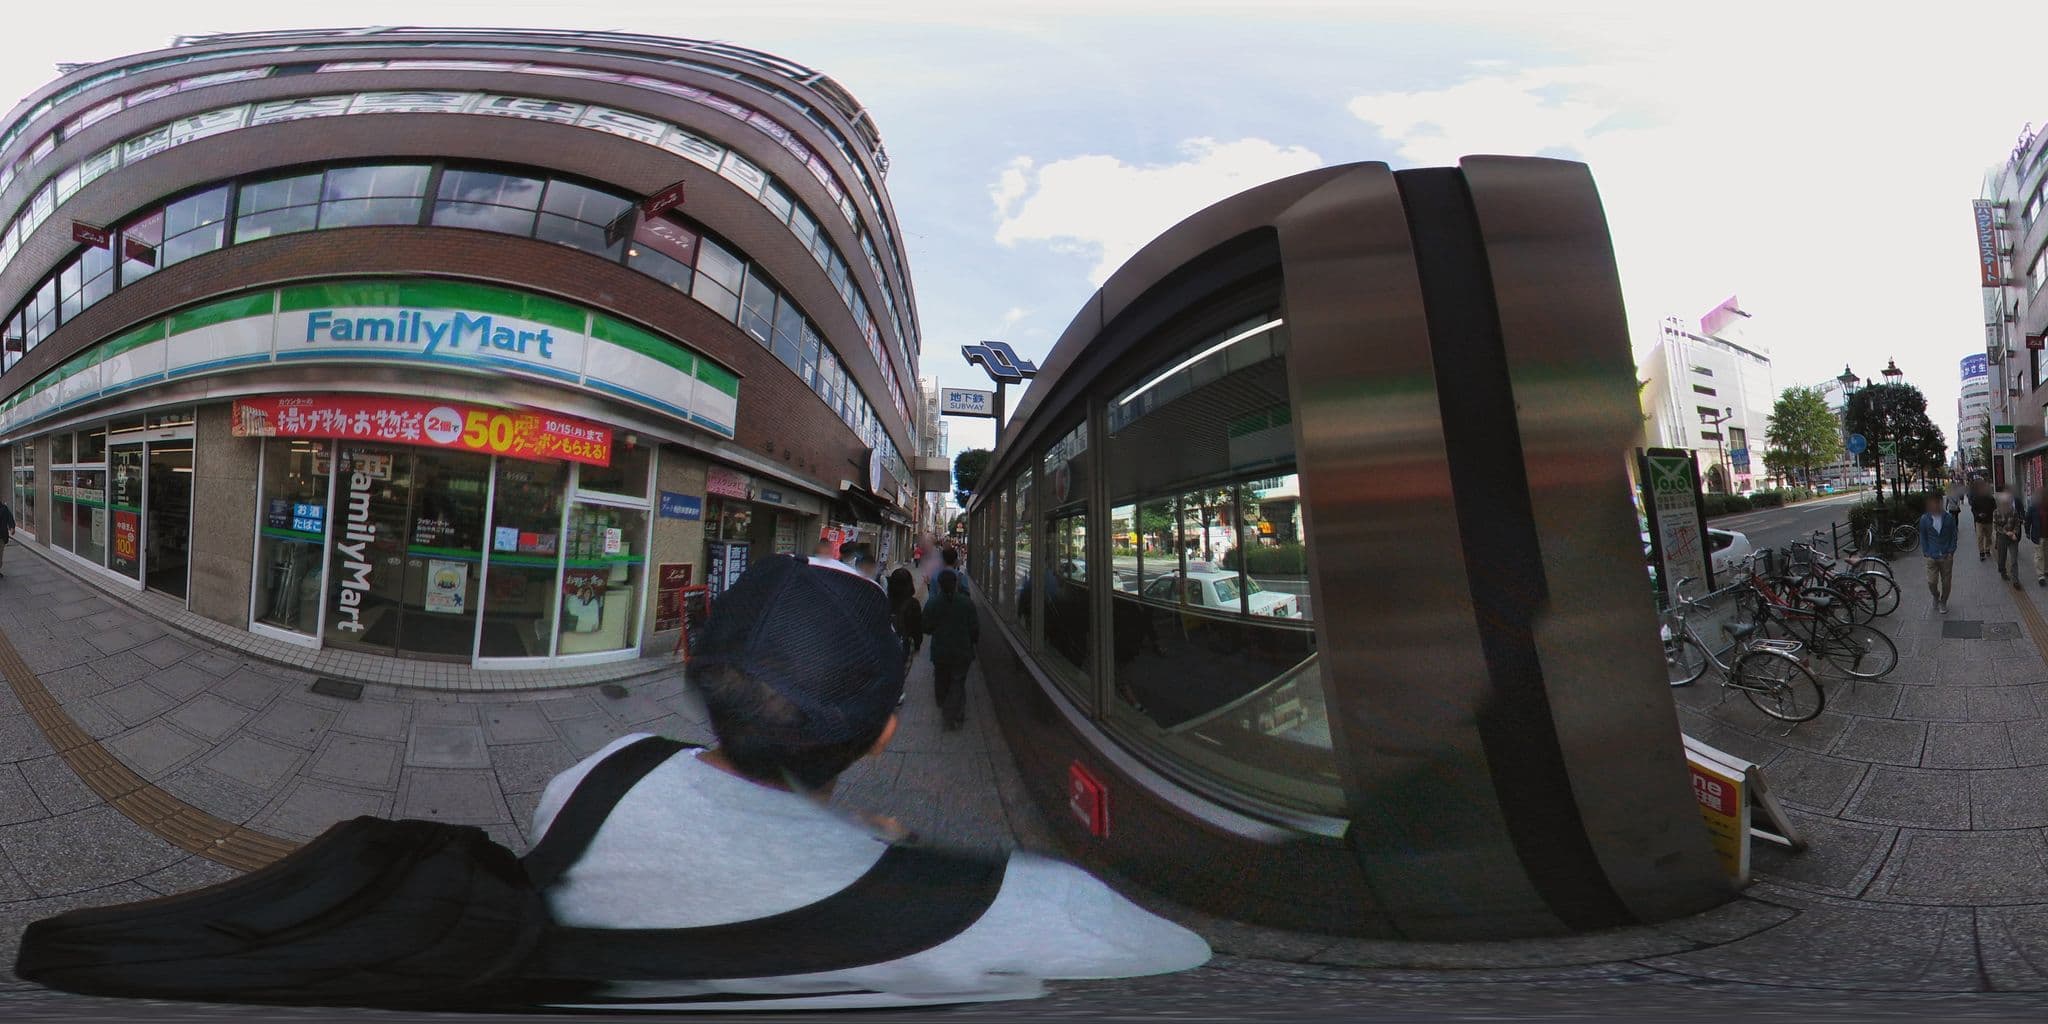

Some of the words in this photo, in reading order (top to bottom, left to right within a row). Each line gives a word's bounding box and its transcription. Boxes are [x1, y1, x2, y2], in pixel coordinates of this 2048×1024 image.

[306, 310, 554, 359] FamilyMart
[950, 391, 985, 404] 地下鉄
[950, 401, 985, 411] SUBWAY
[295, 518, 322, 532] たばこ
